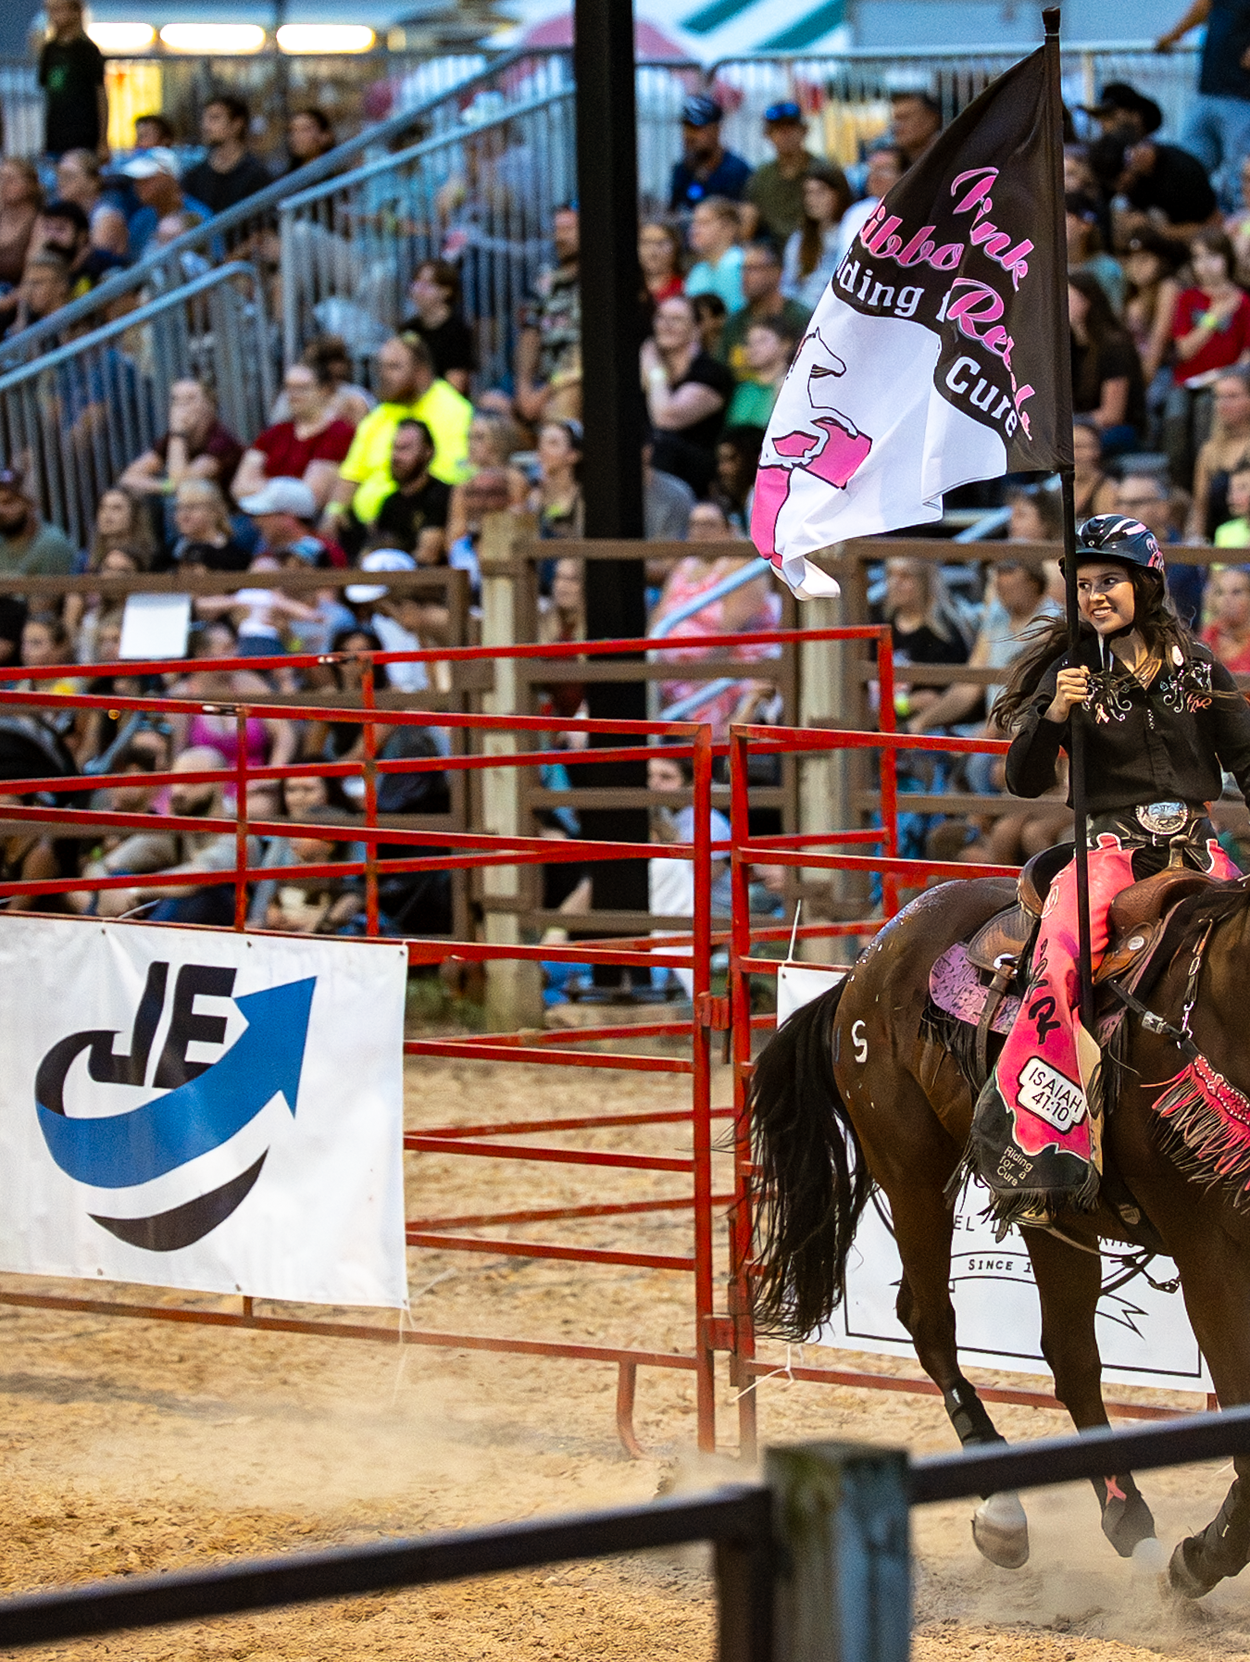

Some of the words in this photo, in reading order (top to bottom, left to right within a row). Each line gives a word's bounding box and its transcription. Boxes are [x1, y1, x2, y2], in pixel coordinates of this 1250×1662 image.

[950, 167, 1035, 292] Pink
[945, 356, 1018, 438] Cure
[1028, 1066, 1083, 1113] ISAIAH
[1031, 1091, 1070, 1122] 41:10
[999, 1155, 1015, 1170] for
[1018, 1171, 1028, 1180] a
[1003, 1145, 1034, 1173] Riding
[996, 1165, 1018, 1187] Cure
[968, 1258, 1014, 1271] SINCE
